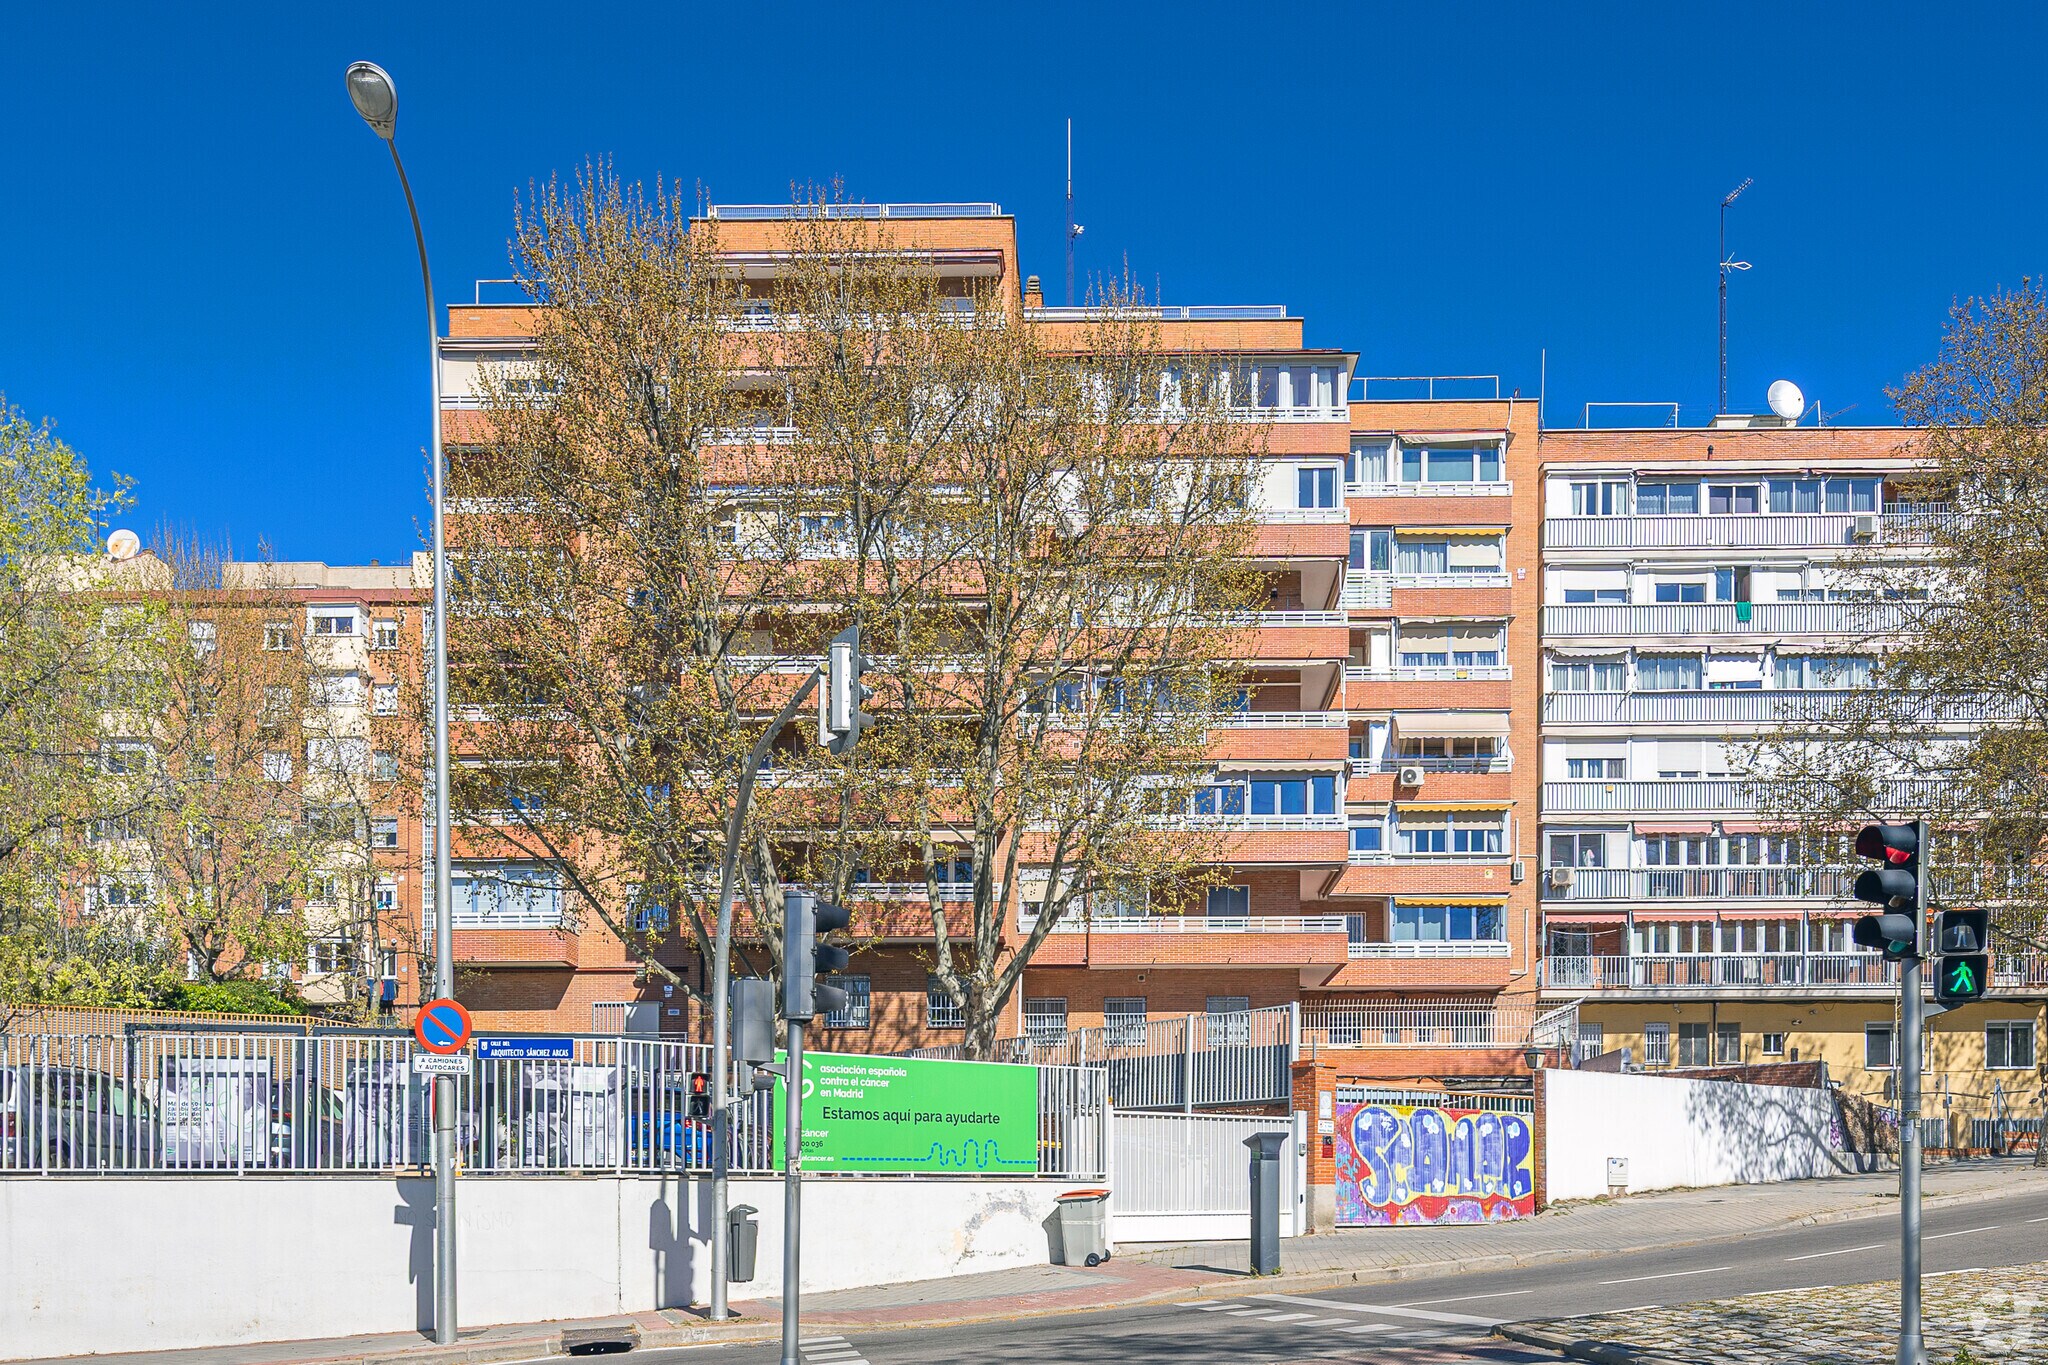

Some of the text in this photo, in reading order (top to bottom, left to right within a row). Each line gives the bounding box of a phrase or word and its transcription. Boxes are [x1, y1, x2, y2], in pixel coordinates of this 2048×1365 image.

[490, 1047, 569, 1058] ARQUITECTO SÁNCHEZ ARCAS
[820, 1064, 907, 1078] asociación española
[820, 1076, 890, 1087] contra el cáncer
[820, 1088, 864, 1098] en Madrid
[822, 1106, 1001, 1126] Estamos aquí para ayudarte
